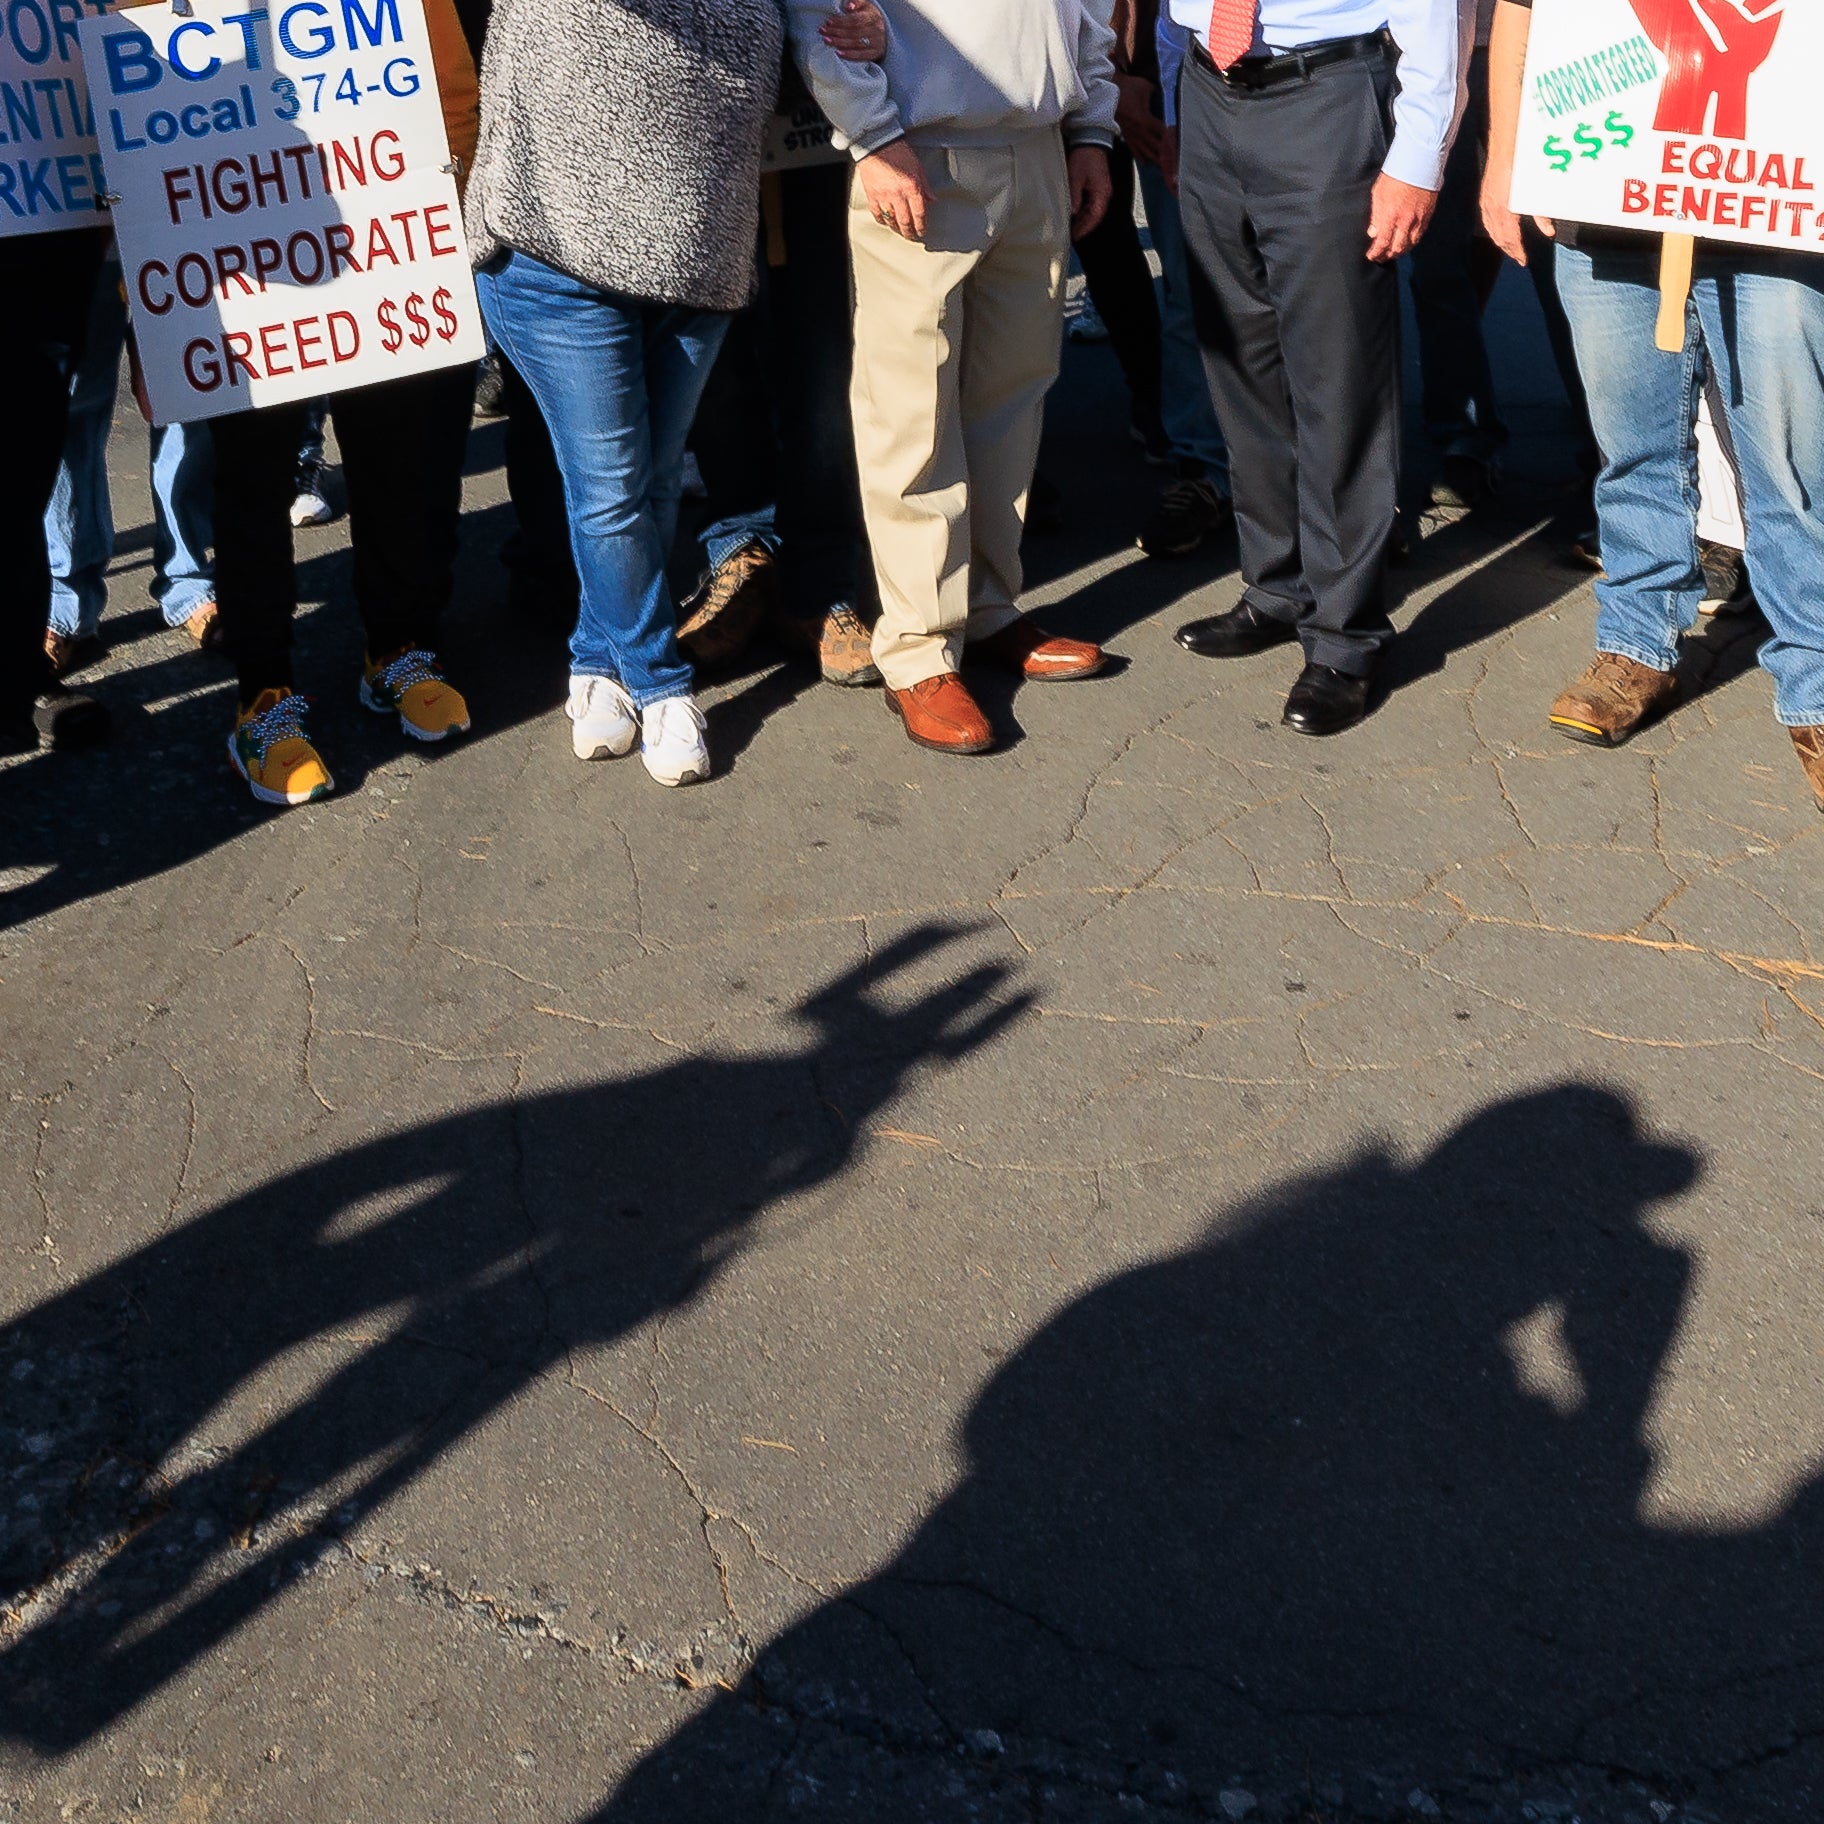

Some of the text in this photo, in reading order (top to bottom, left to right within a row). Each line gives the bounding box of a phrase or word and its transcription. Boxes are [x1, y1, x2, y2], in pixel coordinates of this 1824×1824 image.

[110, 56, 420, 151] Local 374-G
[163, 129, 406, 226] FIGHTING
[1661, 139, 1815, 192] EQUAL
[138, 203, 457, 317] CORPORATE
[183, 286, 459, 394] GREED $$$
